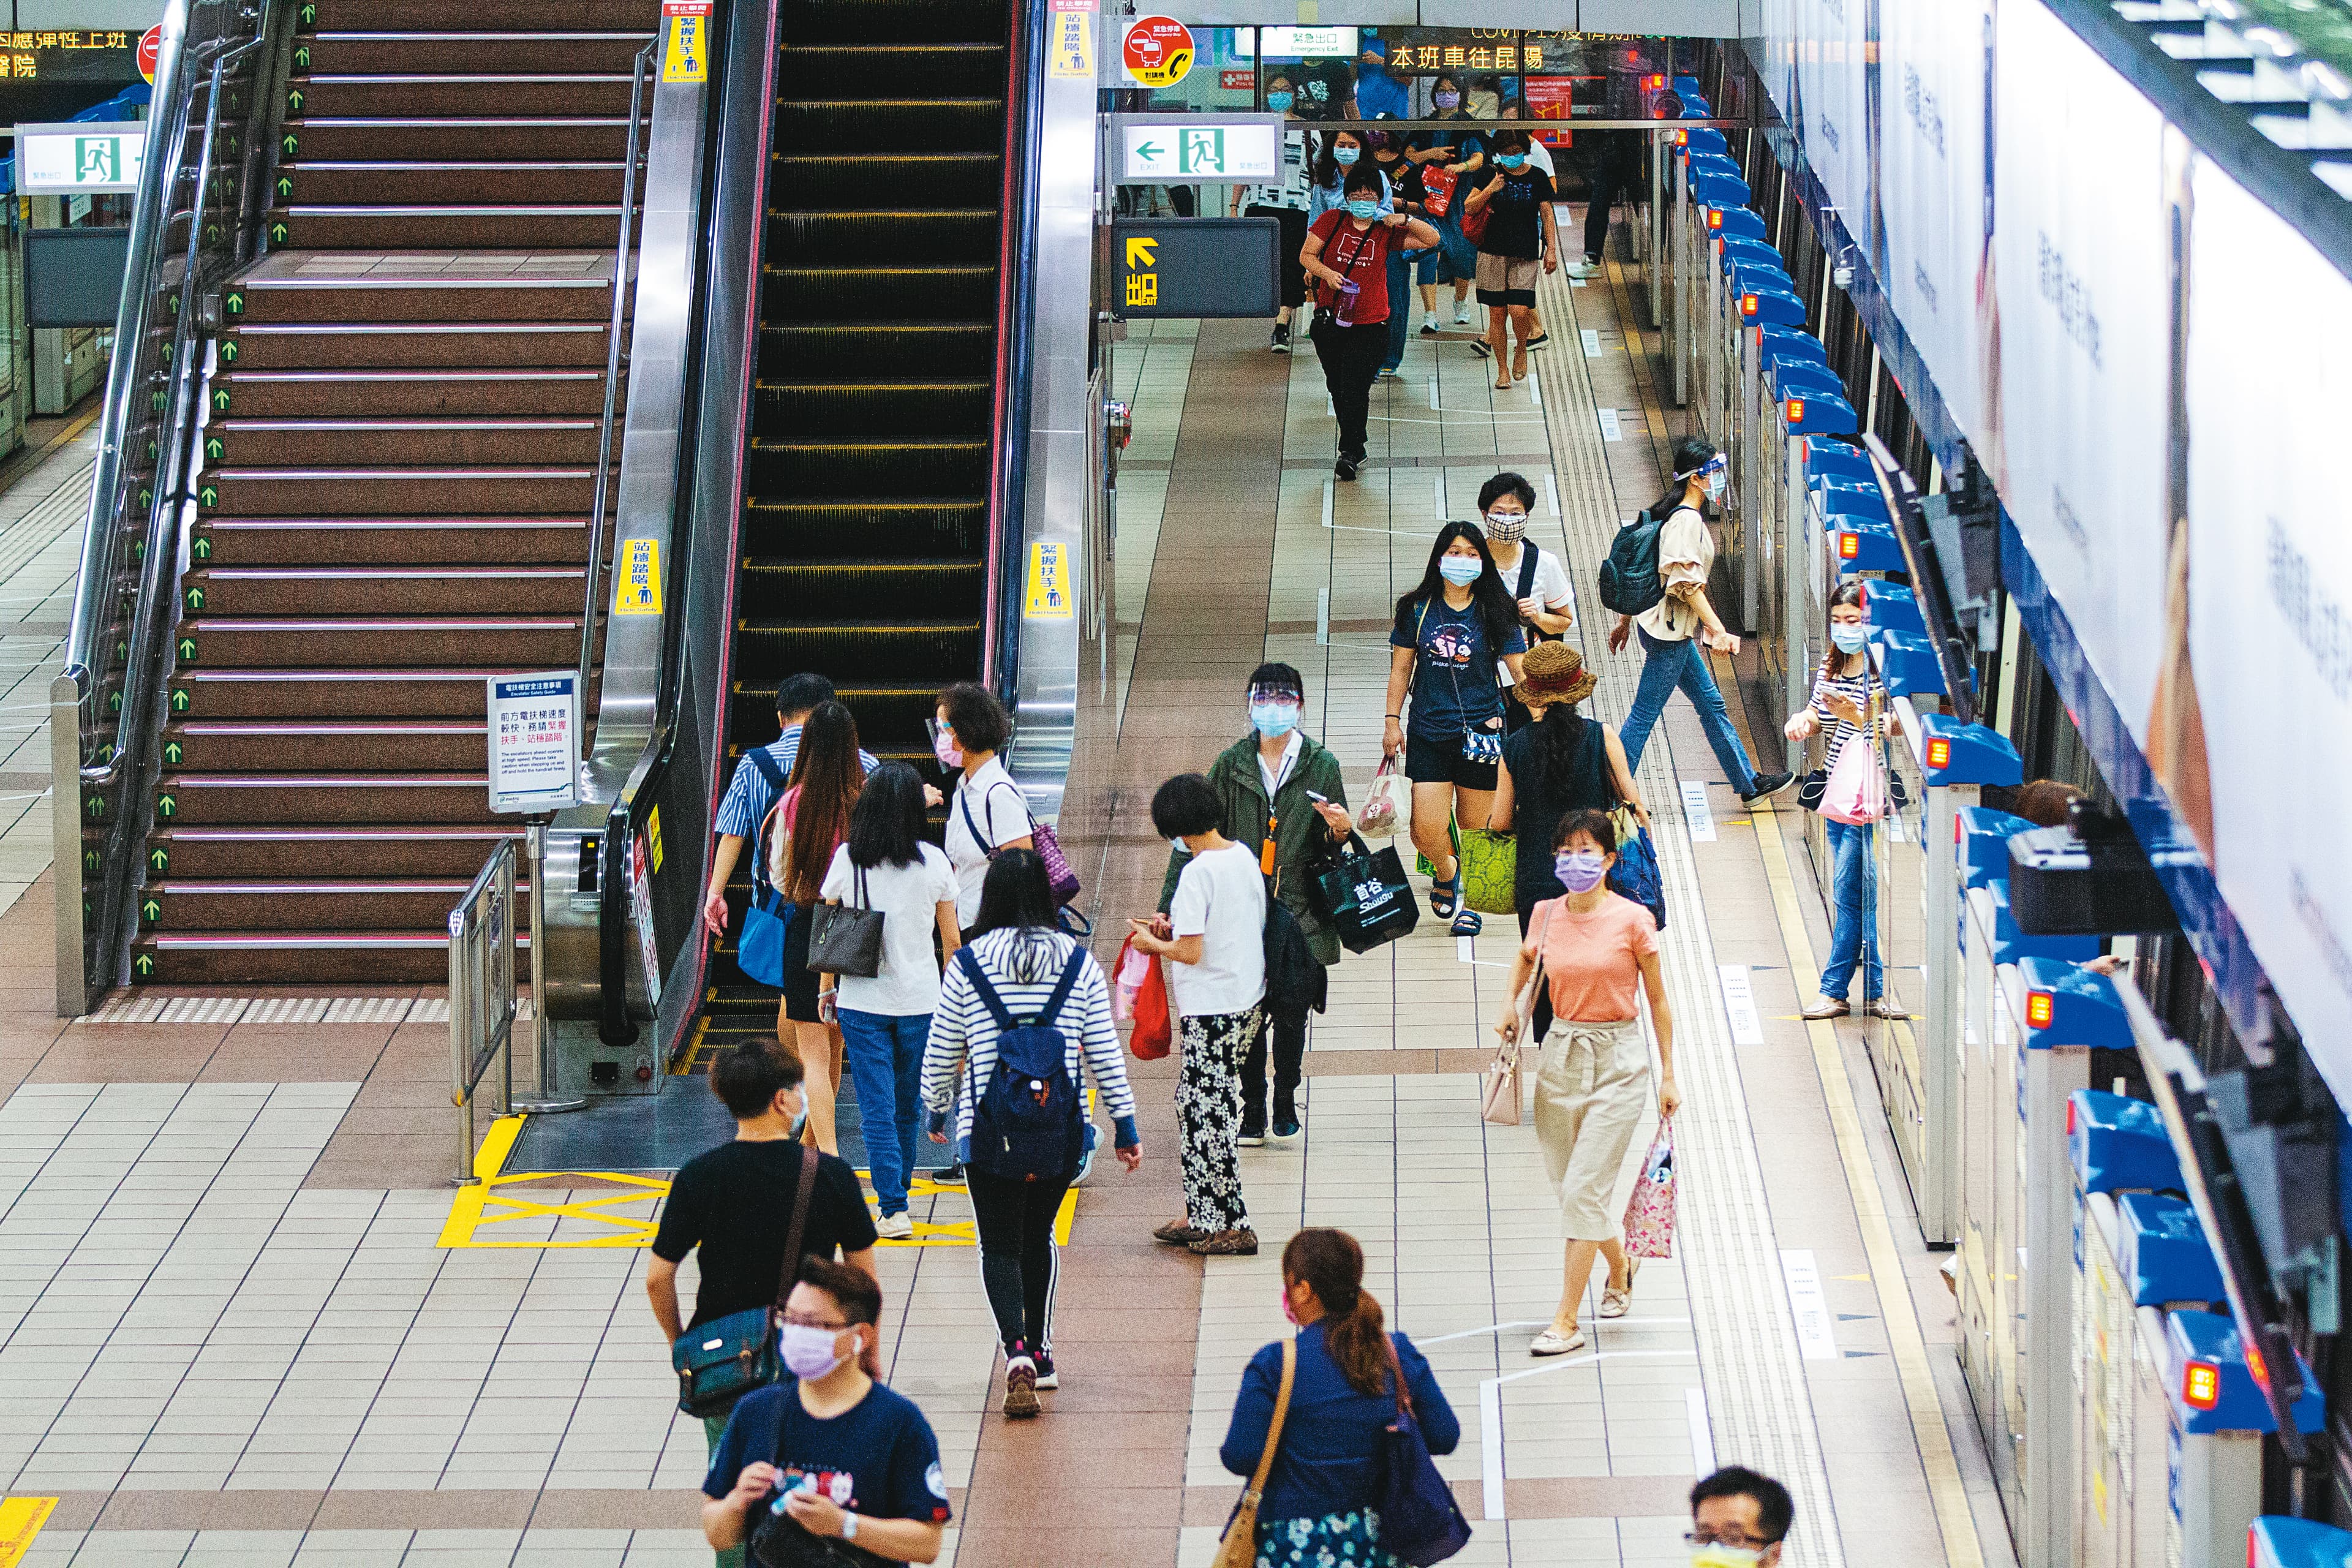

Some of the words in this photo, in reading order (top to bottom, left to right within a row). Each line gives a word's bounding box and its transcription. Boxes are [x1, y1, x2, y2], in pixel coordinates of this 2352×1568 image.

[679, 18, 696, 55] 緊握扶手
[1293, 33, 1336, 43] 緊急出口
[1392, 45, 1543, 69] 本班車往昆陽
[1126, 273, 1158, 306] 出口
[1141, 296, 1158, 306] EXIT
[631, 541, 650, 584] 站穩踏階
[1041, 545, 1057, 587] 緊握扶手
[501, 709, 566, 722] 前方電扶梯速度
[1354, 877, 1382, 902] 首谷
[1359, 892, 1393, 914] Shougu
